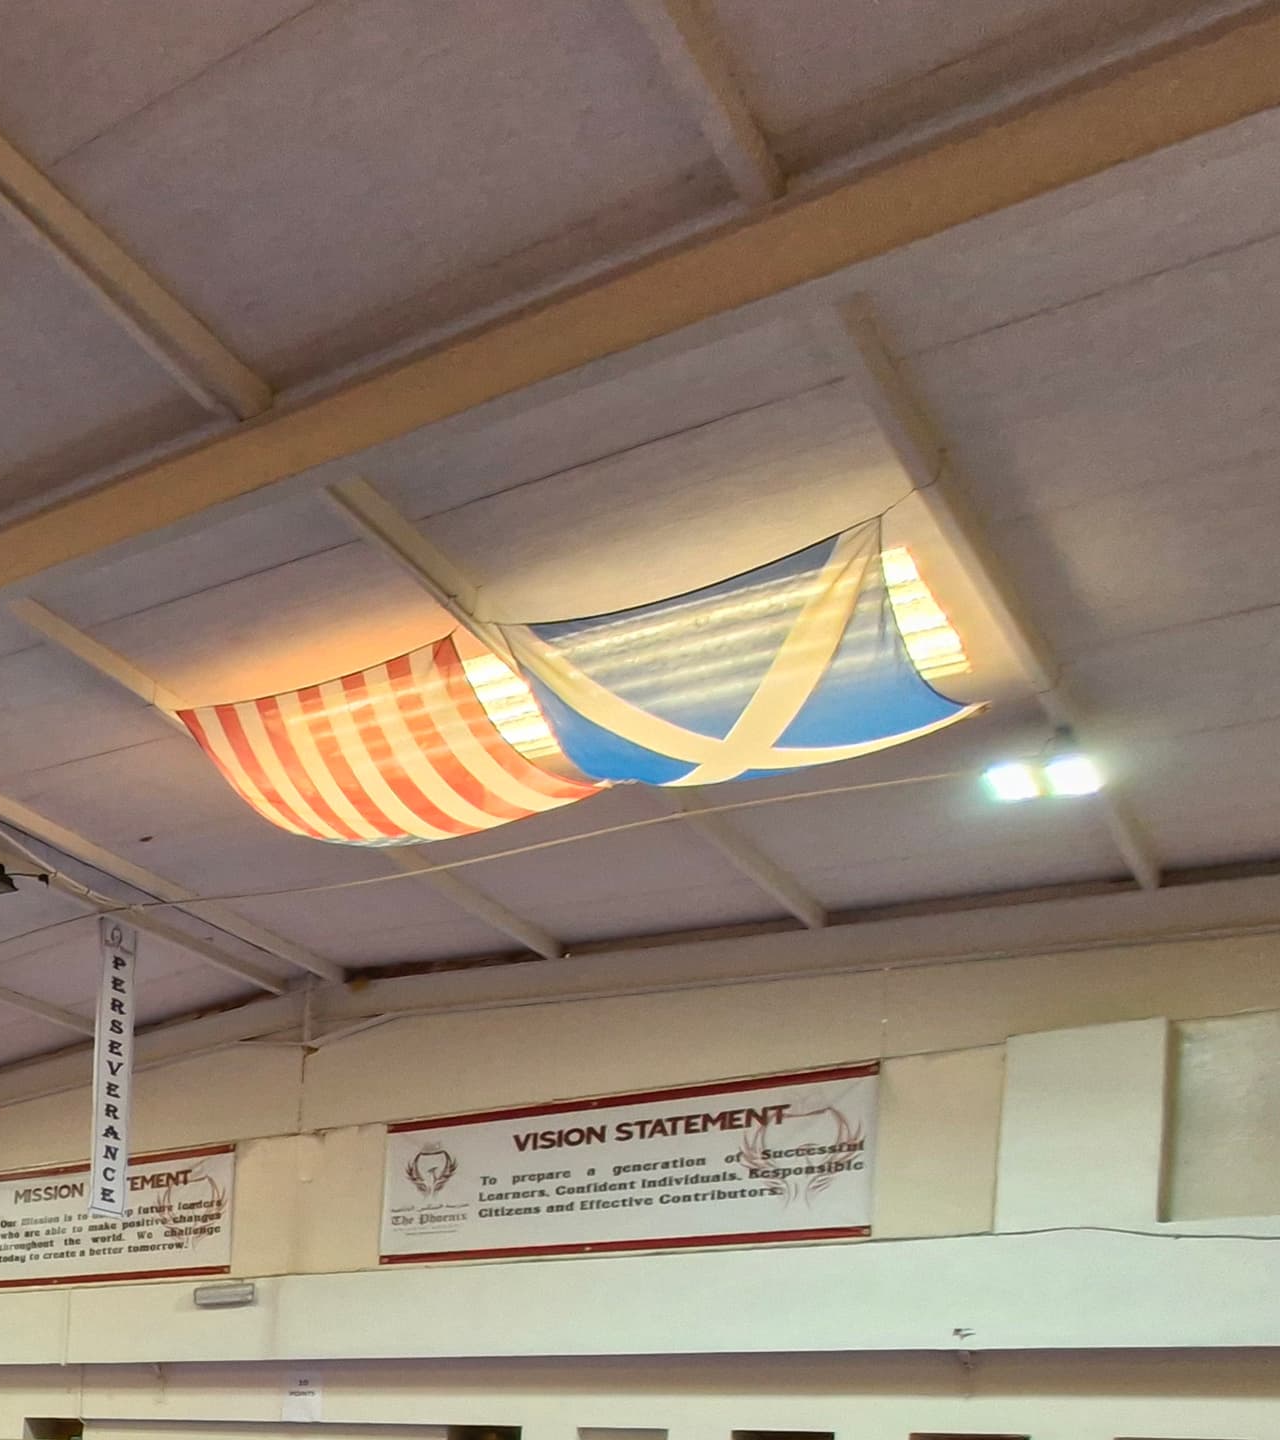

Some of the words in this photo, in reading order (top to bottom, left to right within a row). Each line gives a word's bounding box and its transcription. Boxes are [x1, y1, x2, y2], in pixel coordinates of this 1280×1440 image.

[100, 955, 127, 1203] PERSEVERANCE
[513, 1125, 607, 1152] VISION
[614, 1104, 792, 1142] STATEMENT
[480, 1175, 497, 1186] To
[512, 1169, 571, 1185] prepare
[587, 1168, 596, 1177] a
[612, 1157, 707, 1177] generation
[724, 1151, 742, 1164] of
[761, 1140, 865, 1161] Successful
[555, 1181, 636, 1196] Confident
[748, 1161, 864, 1179] Responsible
[14, 1183, 84, 1204] MISSION
[127, 1169, 192, 1191] EMENT
[478, 1205, 541, 1219] Citizens
[546, 1201, 574, 1213] and
[580, 1196, 653, 1211] Effective
[659, 1186, 784, 1205] Contributors.
[0, 1230, 20, 1240] who
[24, 1229, 40, 1238] are
[45, 1226, 67, 1237] able
[72, 1225, 83, 1233] to
[88, 1222, 117, 1232] make
[122, 1216, 168, 1231] positive
[173, 1212, 222, 1224] changes
[64, 1213, 73, 1223] is
[77, 1212, 88, 1220] to
[138, 1203, 173, 1216] future
[0, 1239, 54, 1252] throughout
[64, 1237, 81, 1246] the
[137, 1231, 153, 1240] We
[163, 1225, 222, 1238] challenge
[29, 1252, 40, 1261] to
[43, 1248, 76, 1259] create
[79, 1249, 85, 1257] a
[89, 1245, 124, 1257] better
[128, 1241, 189, 1253] tomorrow.
